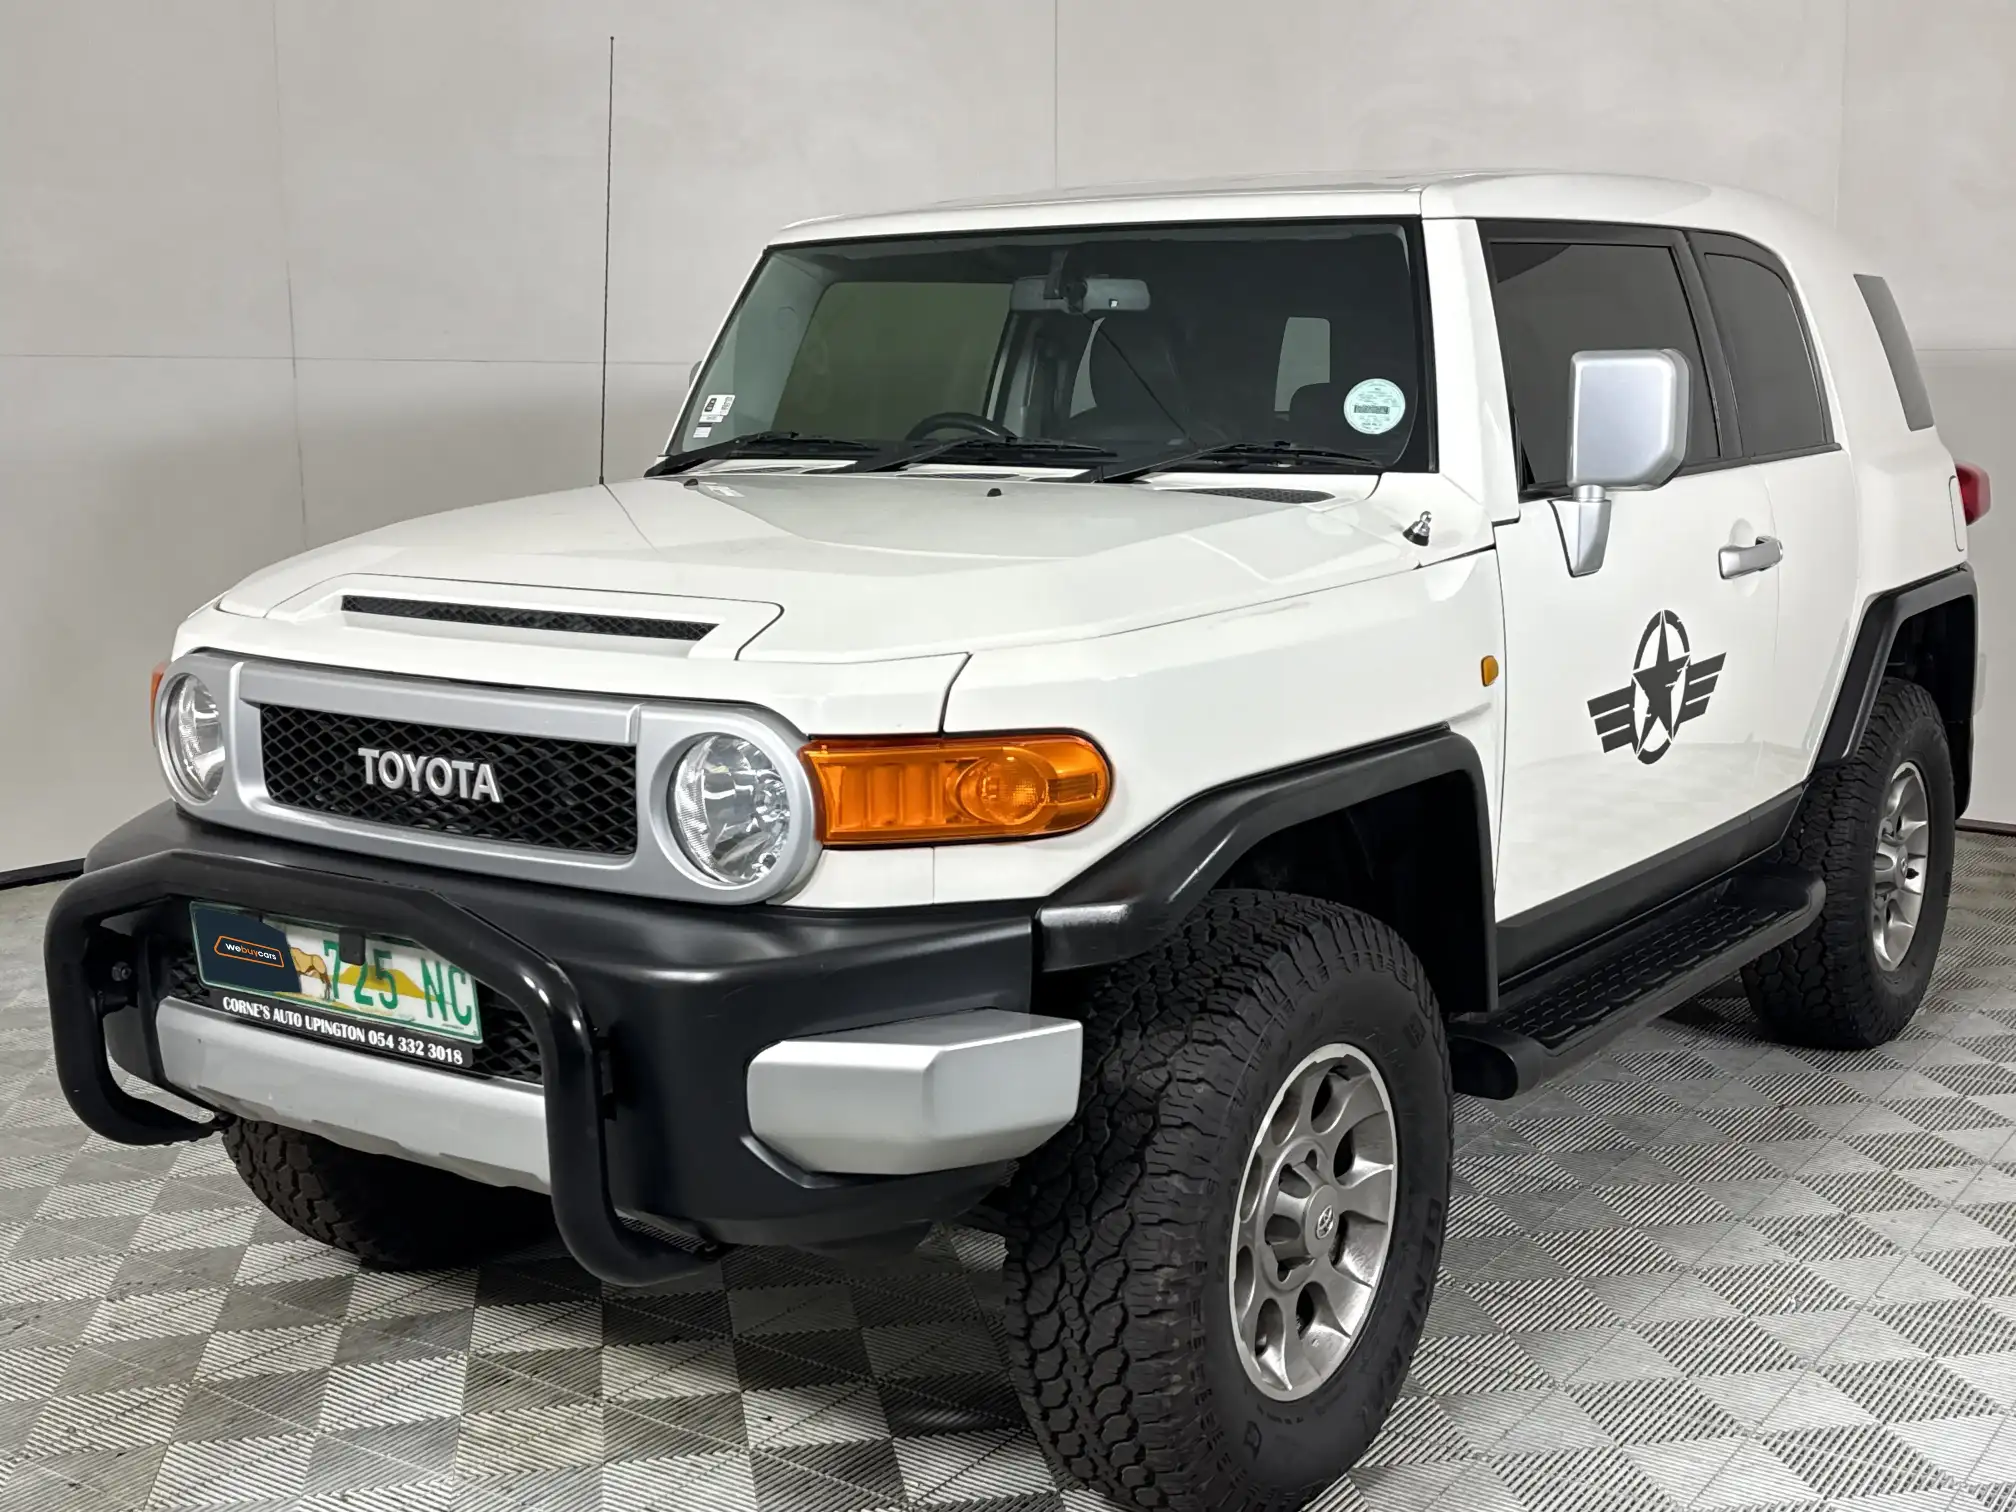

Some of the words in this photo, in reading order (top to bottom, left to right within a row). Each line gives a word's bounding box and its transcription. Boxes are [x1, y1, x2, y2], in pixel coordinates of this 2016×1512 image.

[358, 747, 501, 803] TOYOTA
[420, 957, 472, 1026] NC
[222, 996, 271, 1020] CORNE'S
[273, 1008, 303, 1028] AUTO
[305, 1015, 365, 1043] UPINGTON
[368, 1030, 394, 1049] 054
[398, 1036, 425, 1056] 332
[428, 1043, 464, 1065] 3018
